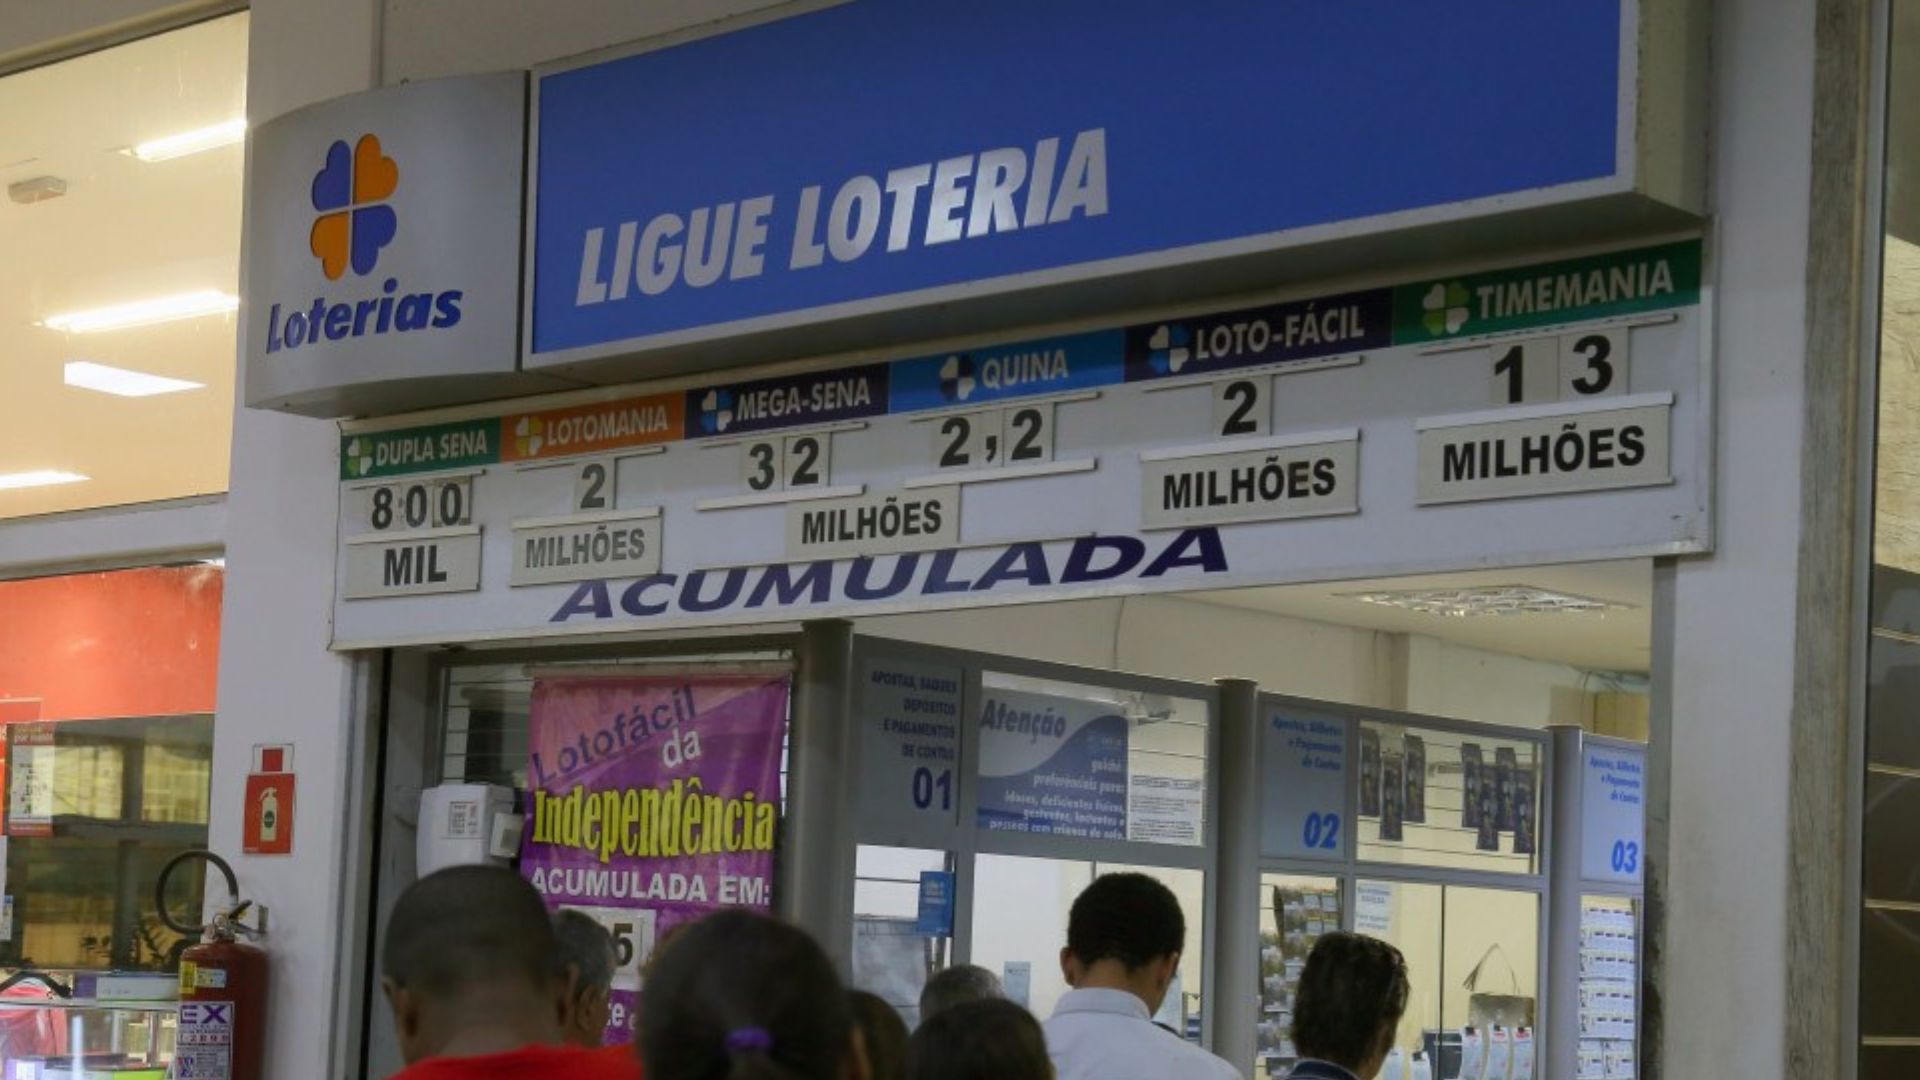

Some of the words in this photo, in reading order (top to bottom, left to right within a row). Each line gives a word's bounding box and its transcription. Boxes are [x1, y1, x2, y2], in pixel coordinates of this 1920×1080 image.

[575, 195, 774, 307] LIGUE
[789, 127, 1109, 270] LOTERIA
[1476, 259, 1675, 321] TIMEMANIA
[267, 278, 463, 355] Loterias
[1195, 302, 1365, 360] LOTO-FÁCIL
[981, 348, 1069, 390] QUINA
[736, 377, 870, 422] MEGA-SENA
[1221, 381, 1258, 436] 2
[375, 438, 434, 467] DUPLA
[439, 428, 487, 457] SENA
[548, 404, 669, 446] LOTOMANIA
[748, 436, 819, 490] 32
[1442, 424, 1646, 482] MILHÕES
[371, 482, 462, 530] 800
[580, 463, 606, 509] 2
[1163, 455, 1336, 510] MILHÕES
[801, 496, 941, 544] MILHÕES
[383, 545, 447, 586] MIL
[525, 524, 645, 568] MILHÕES
[549, 526, 1229, 622] ACUMULADA
[532, 684, 696, 786] Lotofácil
[979, 699, 1066, 744] Atenção
[662, 726, 700, 768] da
[912, 766, 952, 811] 01
[532, 776, 776, 863] Independência
[1303, 811, 1340, 850] 02
[1611, 840, 1638, 874] 03
[531, 867, 707, 902] ACUMULADA
[719, 874, 769, 905] EM:
